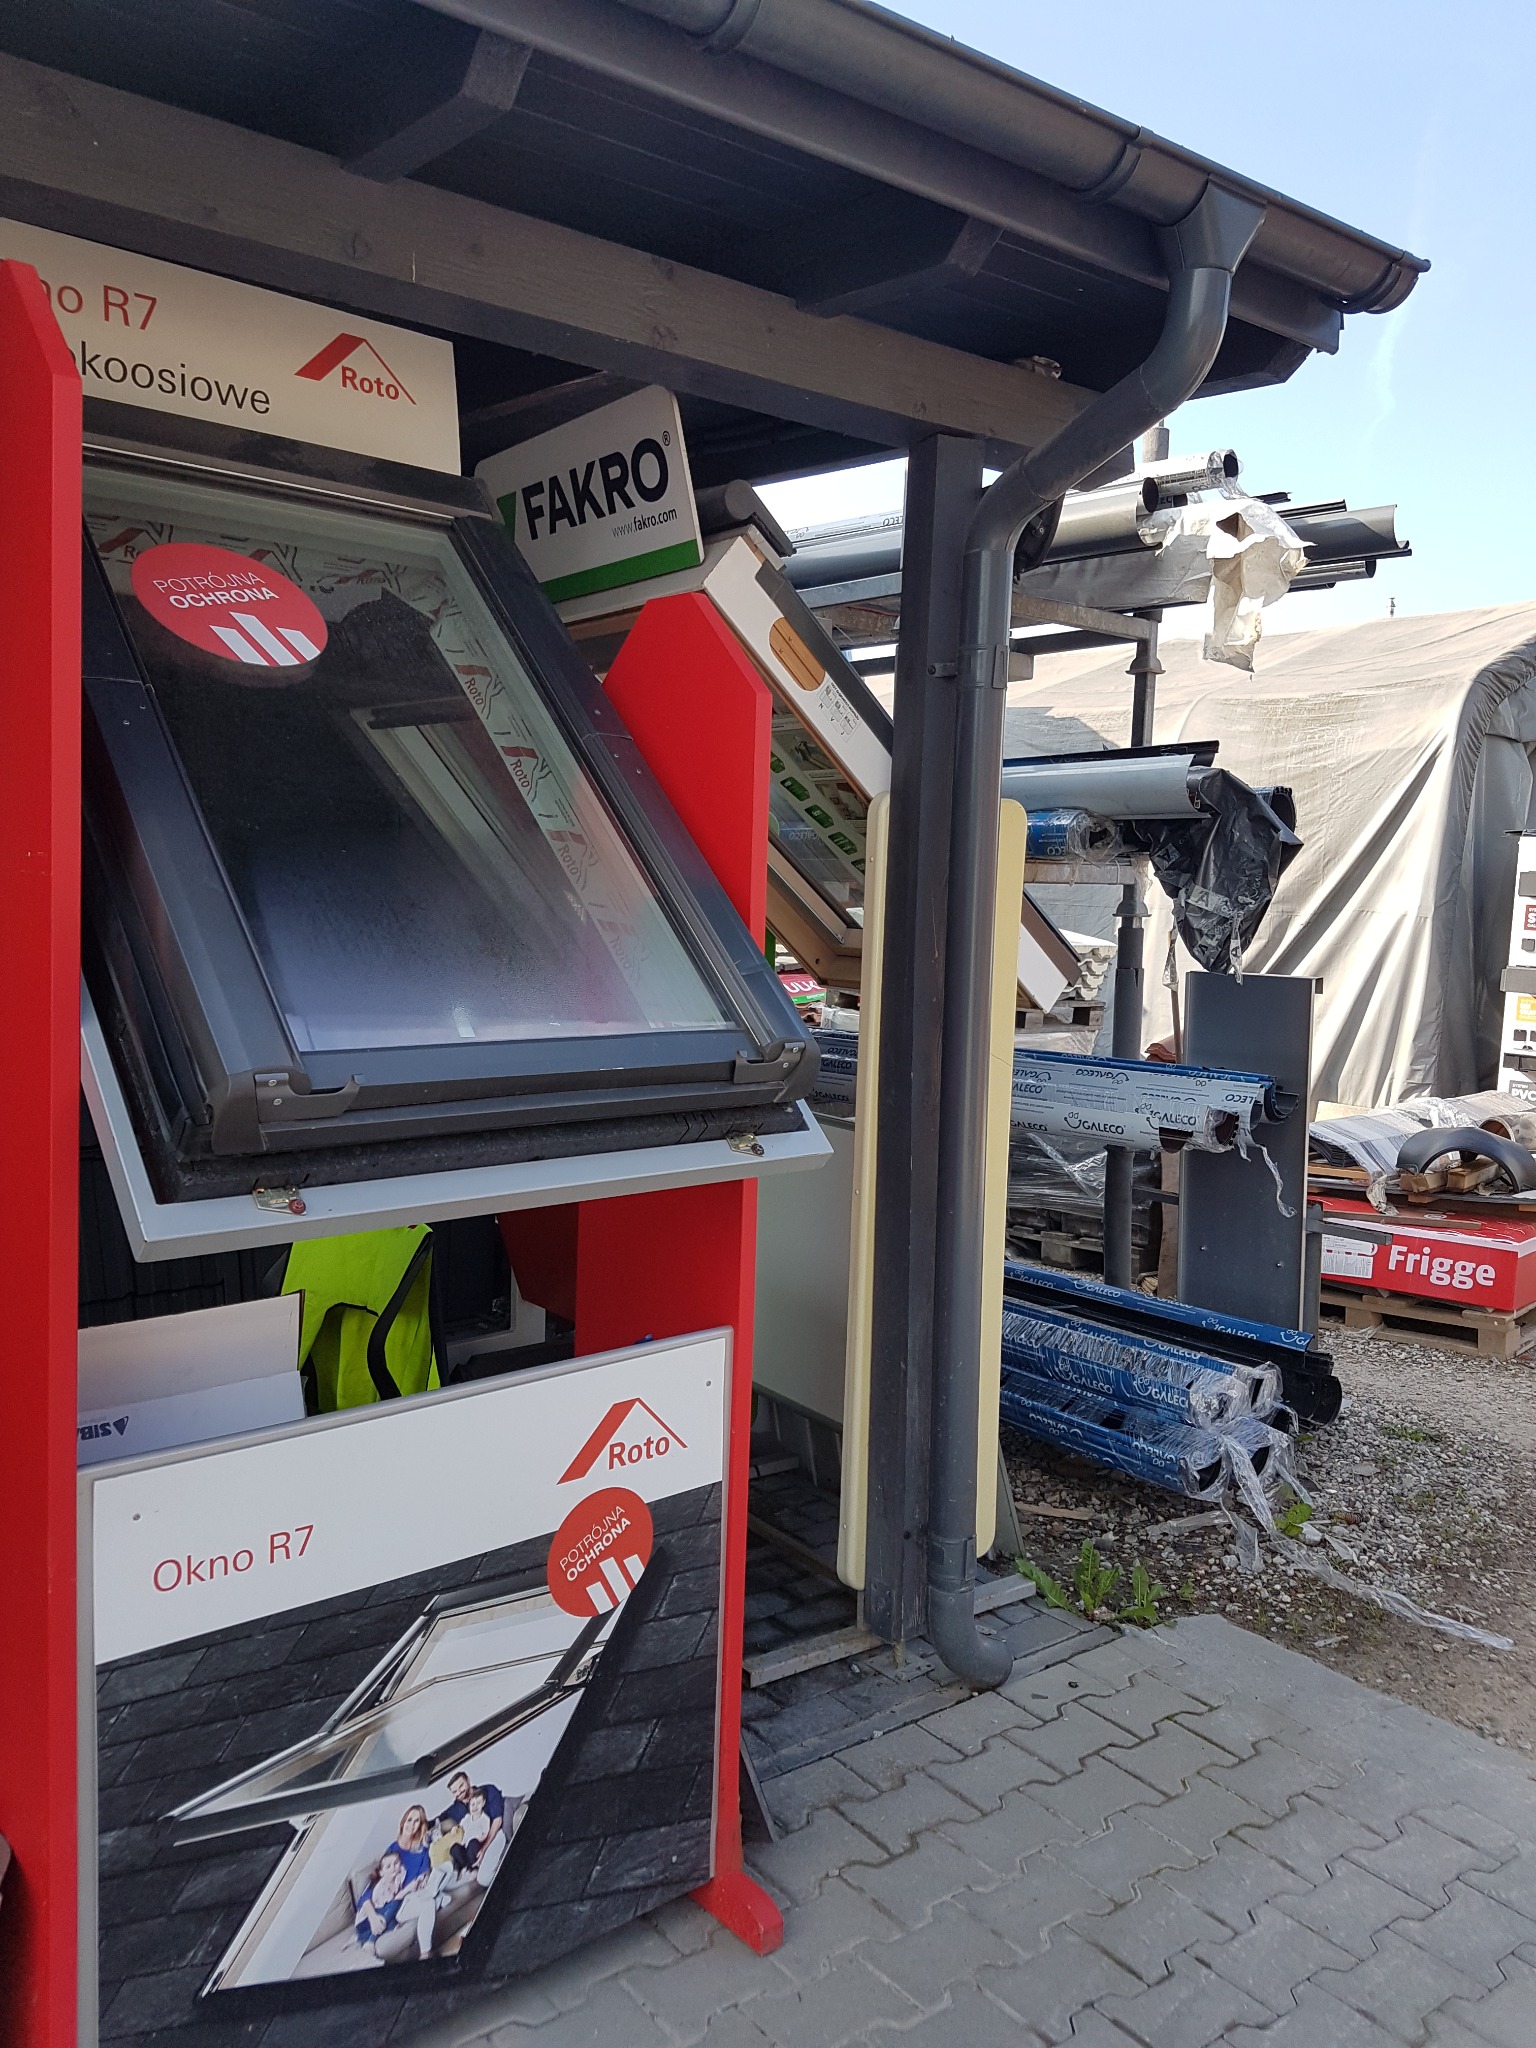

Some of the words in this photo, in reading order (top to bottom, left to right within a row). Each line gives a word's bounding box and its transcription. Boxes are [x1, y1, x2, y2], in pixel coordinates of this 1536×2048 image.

[103, 284, 158, 331] R7
[68, 340, 271, 415] koosiowe
[341, 365, 400, 401] Roto
[611, 508, 678, 539] www.fakro.com
[152, 571, 266, 594] POTRÓJNA
[168, 586, 280, 610] OCHRONA
[464, 677, 484, 707] Roto
[509, 758, 531, 790] Roto
[557, 844, 580, 878] Roto
[822, 1060, 853, 1070] GALECO
[1075, 1068, 1115, 1080] GALECO
[1082, 1120, 1125, 1135] GALECO
[1152, 1110, 1197, 1126] GALECO
[1388, 1244, 1496, 1290] Frigge
[1086, 1285, 1121, 1298] GALECO
[1072, 1375, 1113, 1395] GALECO
[76, 1422, 112, 1441] SIB
[608, 1435, 671, 1471] Roto
[559, 1505, 626, 1572] POTRÓJNA
[566, 1517, 631, 1582] OCHRONA
[152, 1549, 254, 1593] Okno
[269, 1524, 314, 1565] R7
